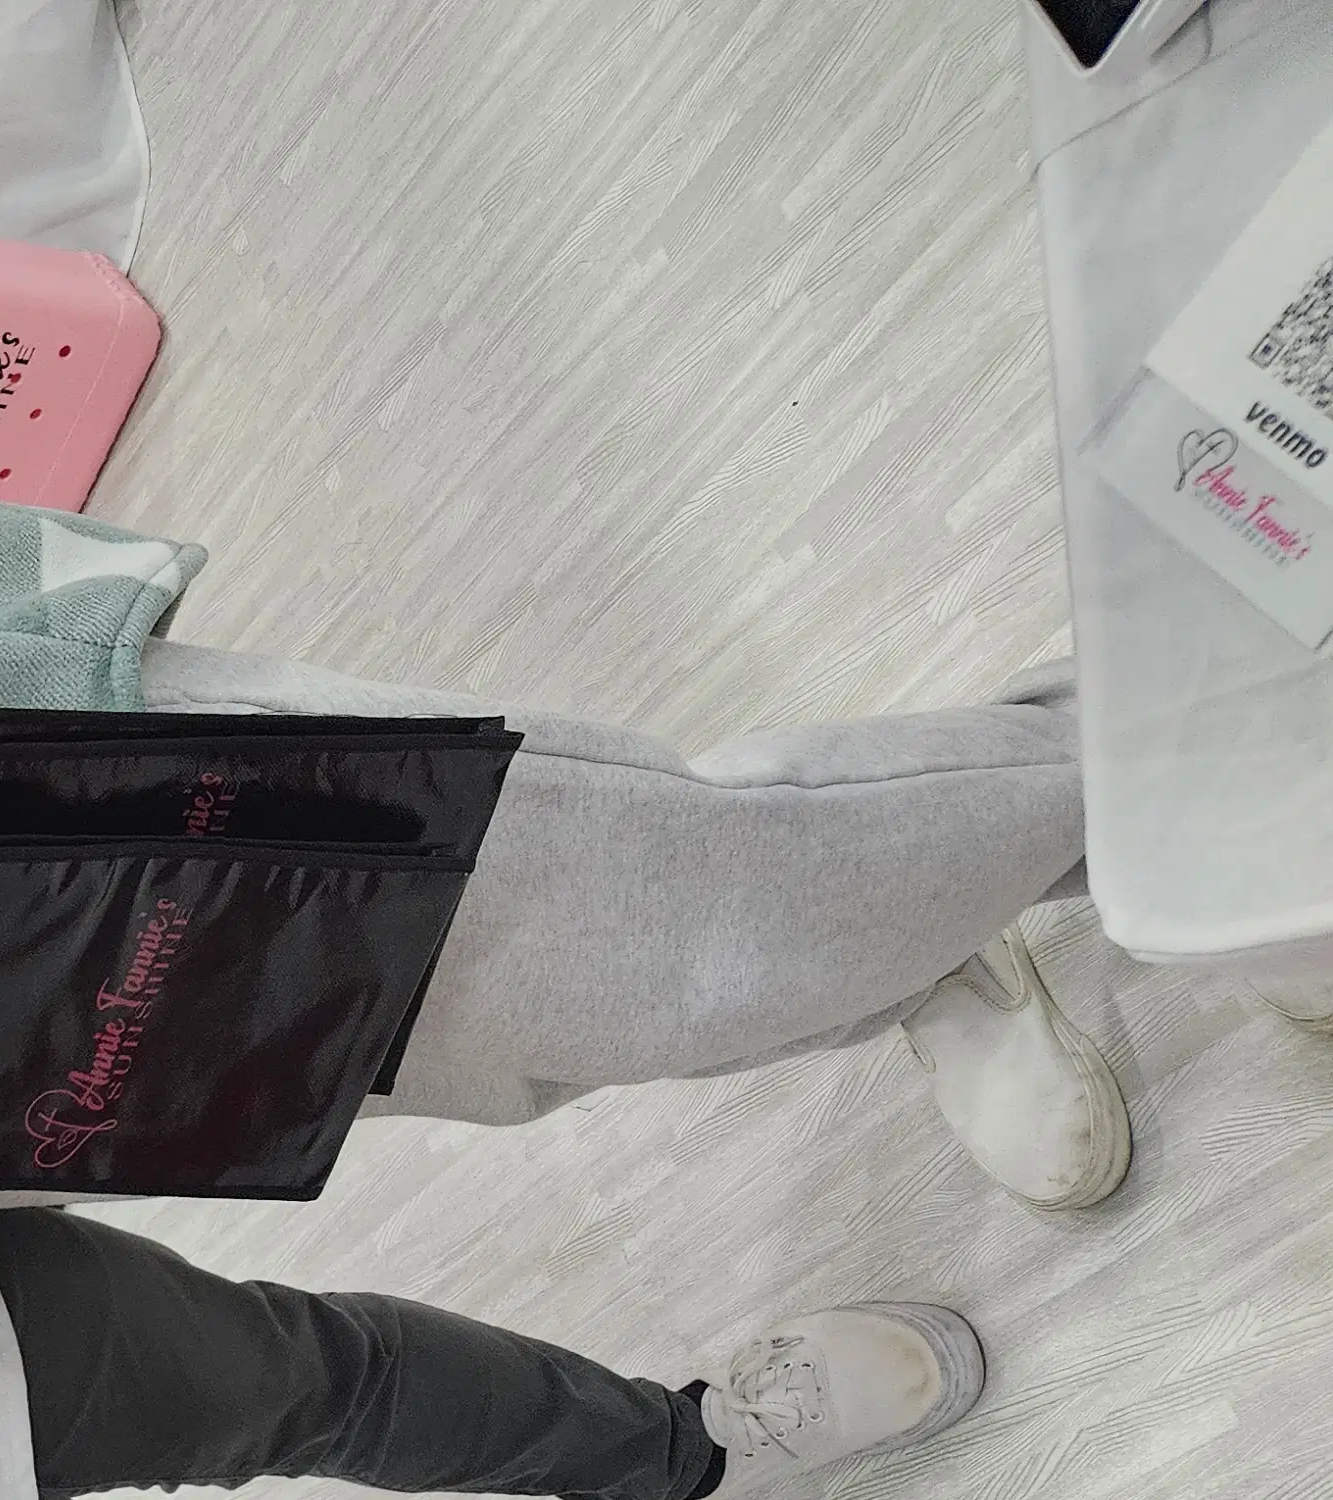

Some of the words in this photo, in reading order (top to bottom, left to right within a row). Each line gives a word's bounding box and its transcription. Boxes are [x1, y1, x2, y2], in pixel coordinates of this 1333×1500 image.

[1243, 400, 1328, 469] venmo
[96, 898, 177, 1011] Fannie's
[68, 1017, 126, 1110] Annie
